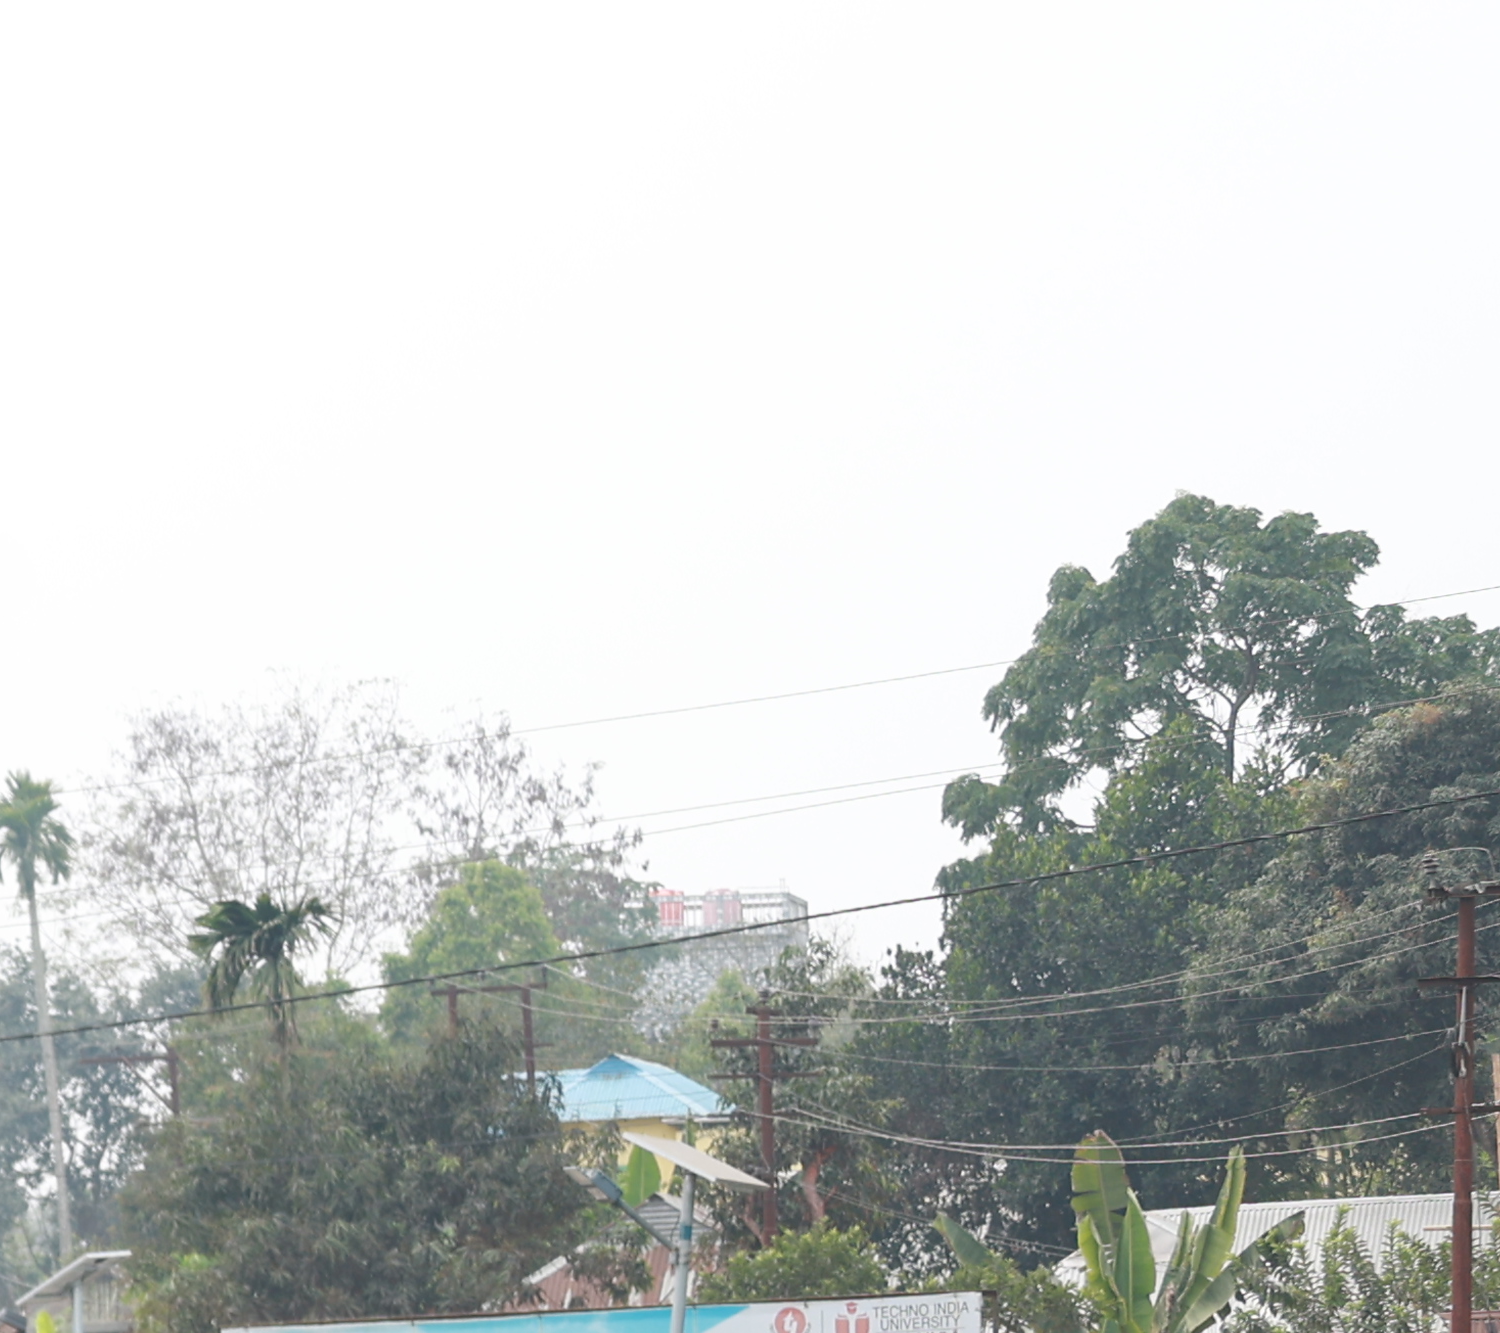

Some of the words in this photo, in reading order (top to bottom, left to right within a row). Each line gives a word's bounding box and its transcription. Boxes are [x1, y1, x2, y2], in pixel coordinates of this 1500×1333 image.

[872, 1303, 928, 1319] TECHNO
[934, 1301, 969, 1316] INDIA
[879, 1315, 960, 1331] UNIVERSITY
